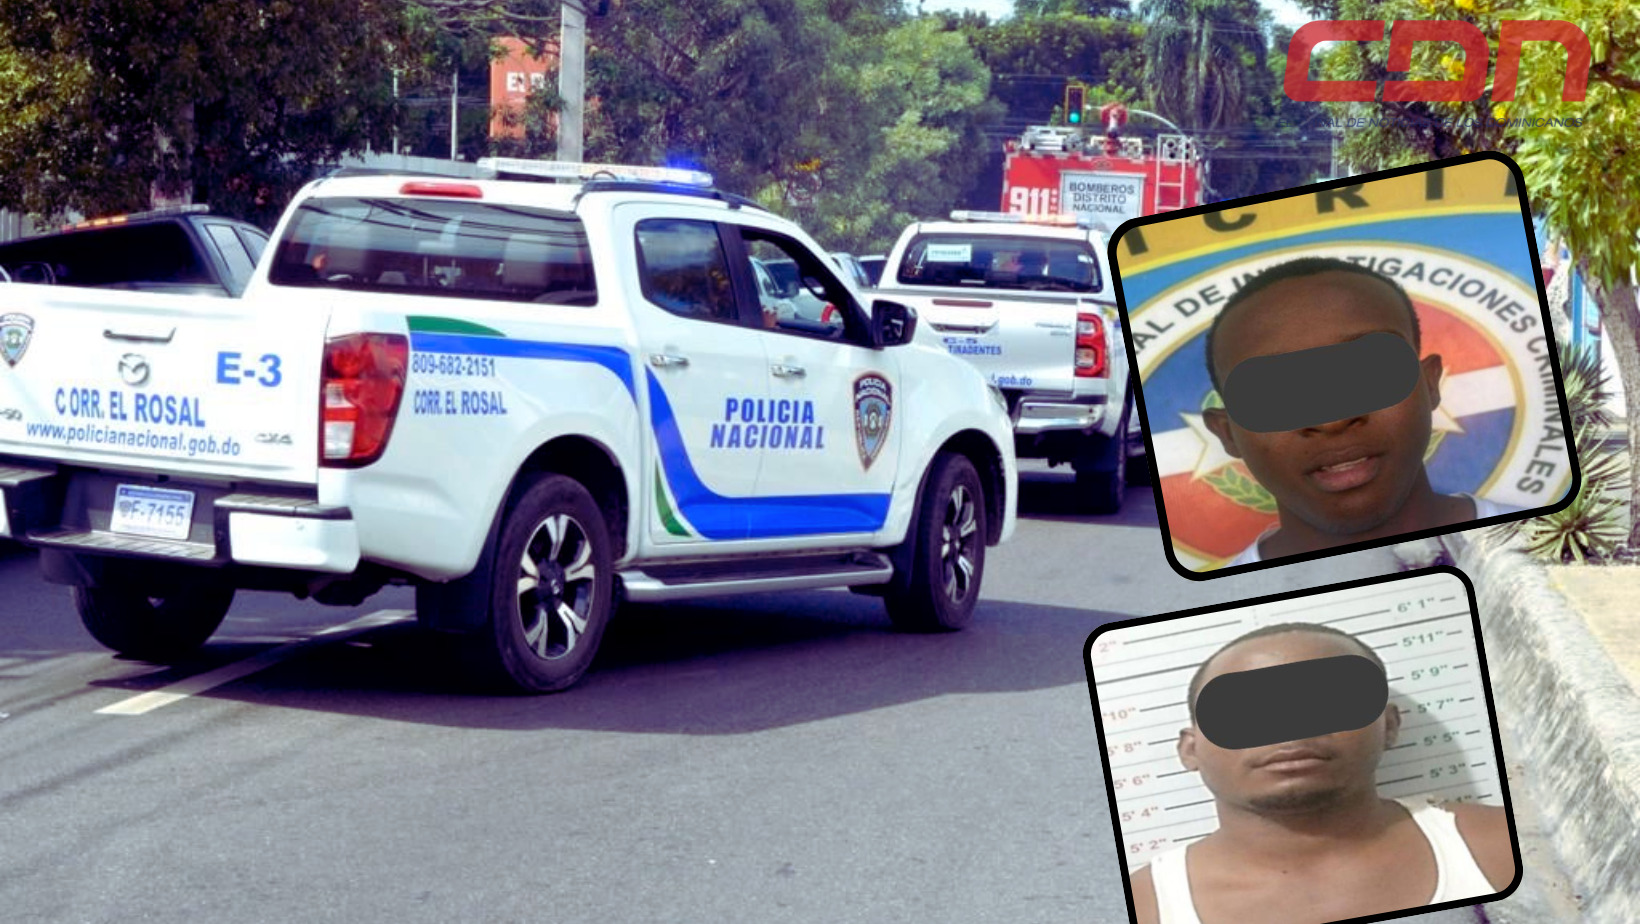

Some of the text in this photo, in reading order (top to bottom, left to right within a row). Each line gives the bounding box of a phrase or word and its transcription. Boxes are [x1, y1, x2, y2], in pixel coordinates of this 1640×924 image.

[1009, 187, 1050, 216] 911
[1069, 182, 1135, 195] BOMBEROS
[1073, 193, 1127, 204] DISTRITO
[1072, 203, 1126, 214] NACIONAL
[1131, 320, 1175, 354] AL
[1173, 284, 1226, 318] DE
[215, 351, 283, 388] E-3
[412, 353, 496, 377] 809-682-2151
[109, 391, 128, 421] EL
[134, 392, 206, 428] ROSAL
[413, 390, 508, 415] CORR. EL ROSAL
[725, 398, 815, 424] POLICIA
[26, 422, 241, 457] www.policianacional.gob.do
[710, 423, 825, 449] NACIONAL
